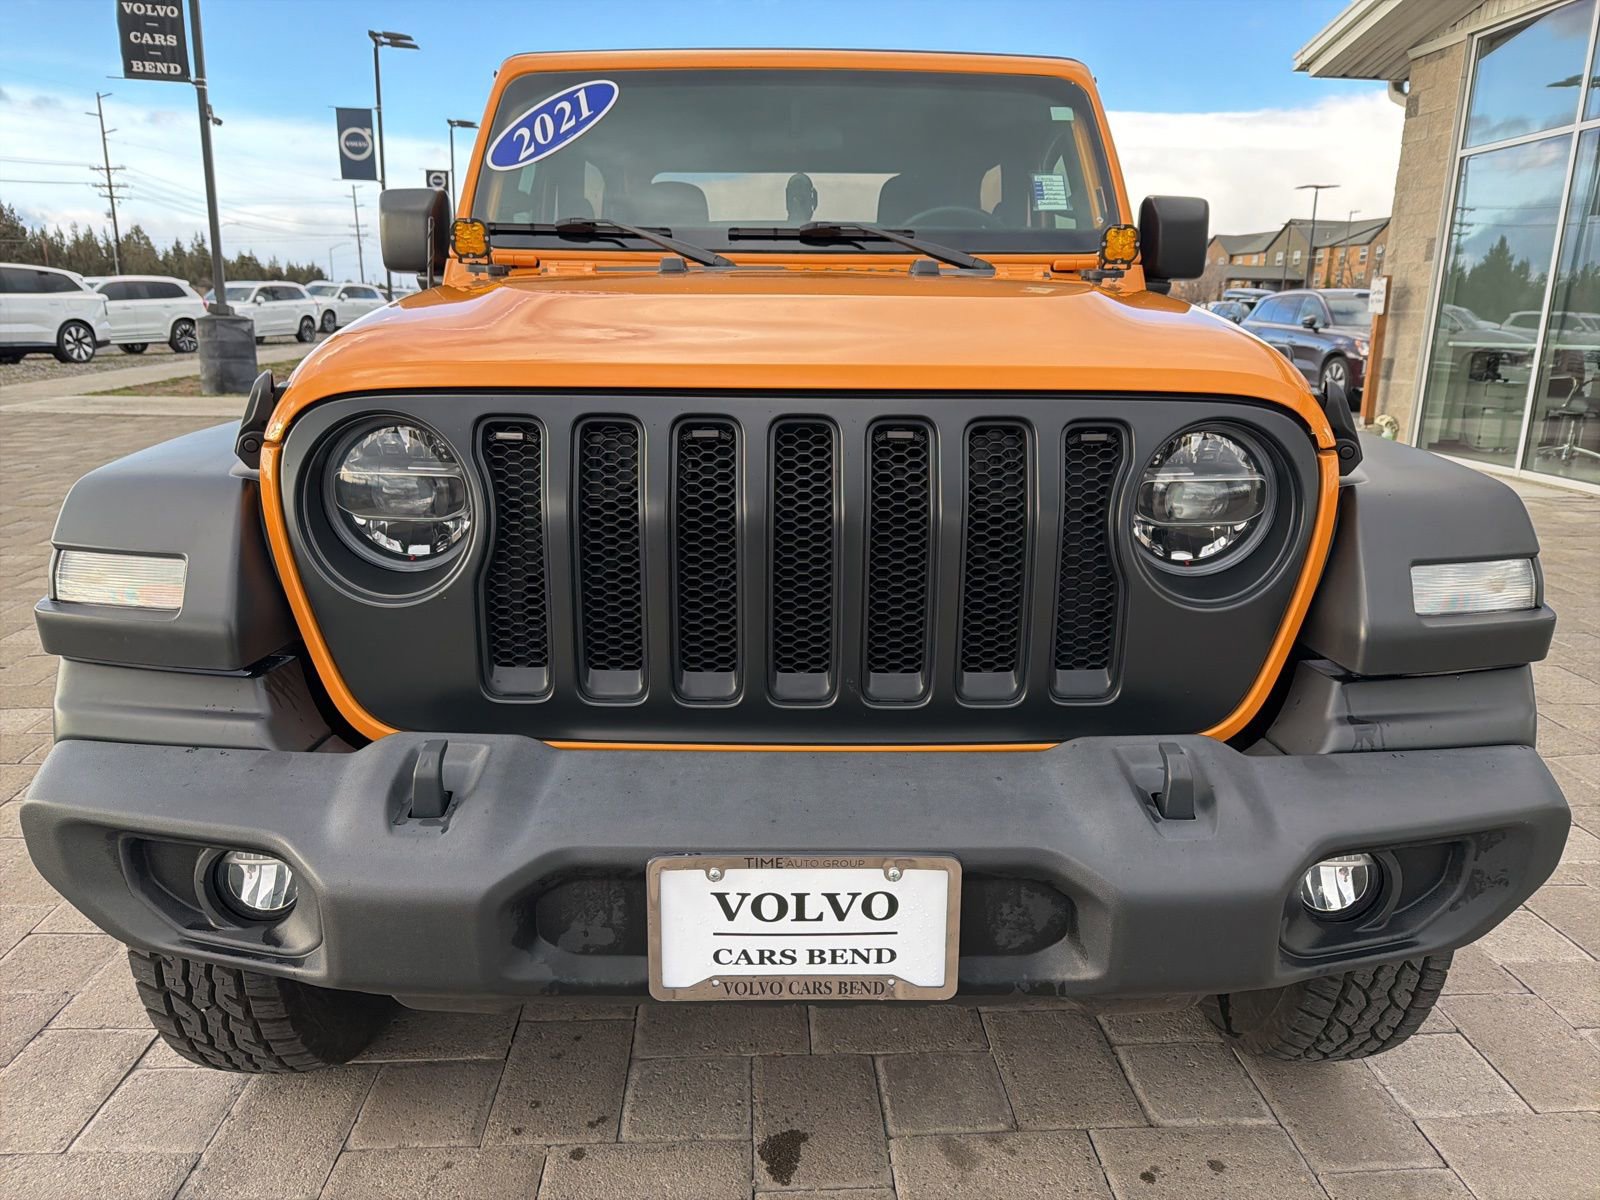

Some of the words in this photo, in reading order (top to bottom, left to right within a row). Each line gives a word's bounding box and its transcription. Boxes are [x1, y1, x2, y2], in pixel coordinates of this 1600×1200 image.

[121, 1, 179, 18] VOLVO
[129, 31, 178, 47] CARS
[130, 60, 182, 75] BEND
[513, 88, 594, 161] 2021
[744, 857, 784, 869] TIME
[785, 859, 819, 869] AUTO
[822, 859, 865, 869] GROUP
[710, 891, 899, 922] VOLVO
[712, 948, 798, 966] CARS
[806, 947, 897, 965] BEND
[722, 981, 783, 996] VOLVO
[788, 980, 833, 996] CARS
[837, 980, 885, 995] BEND
